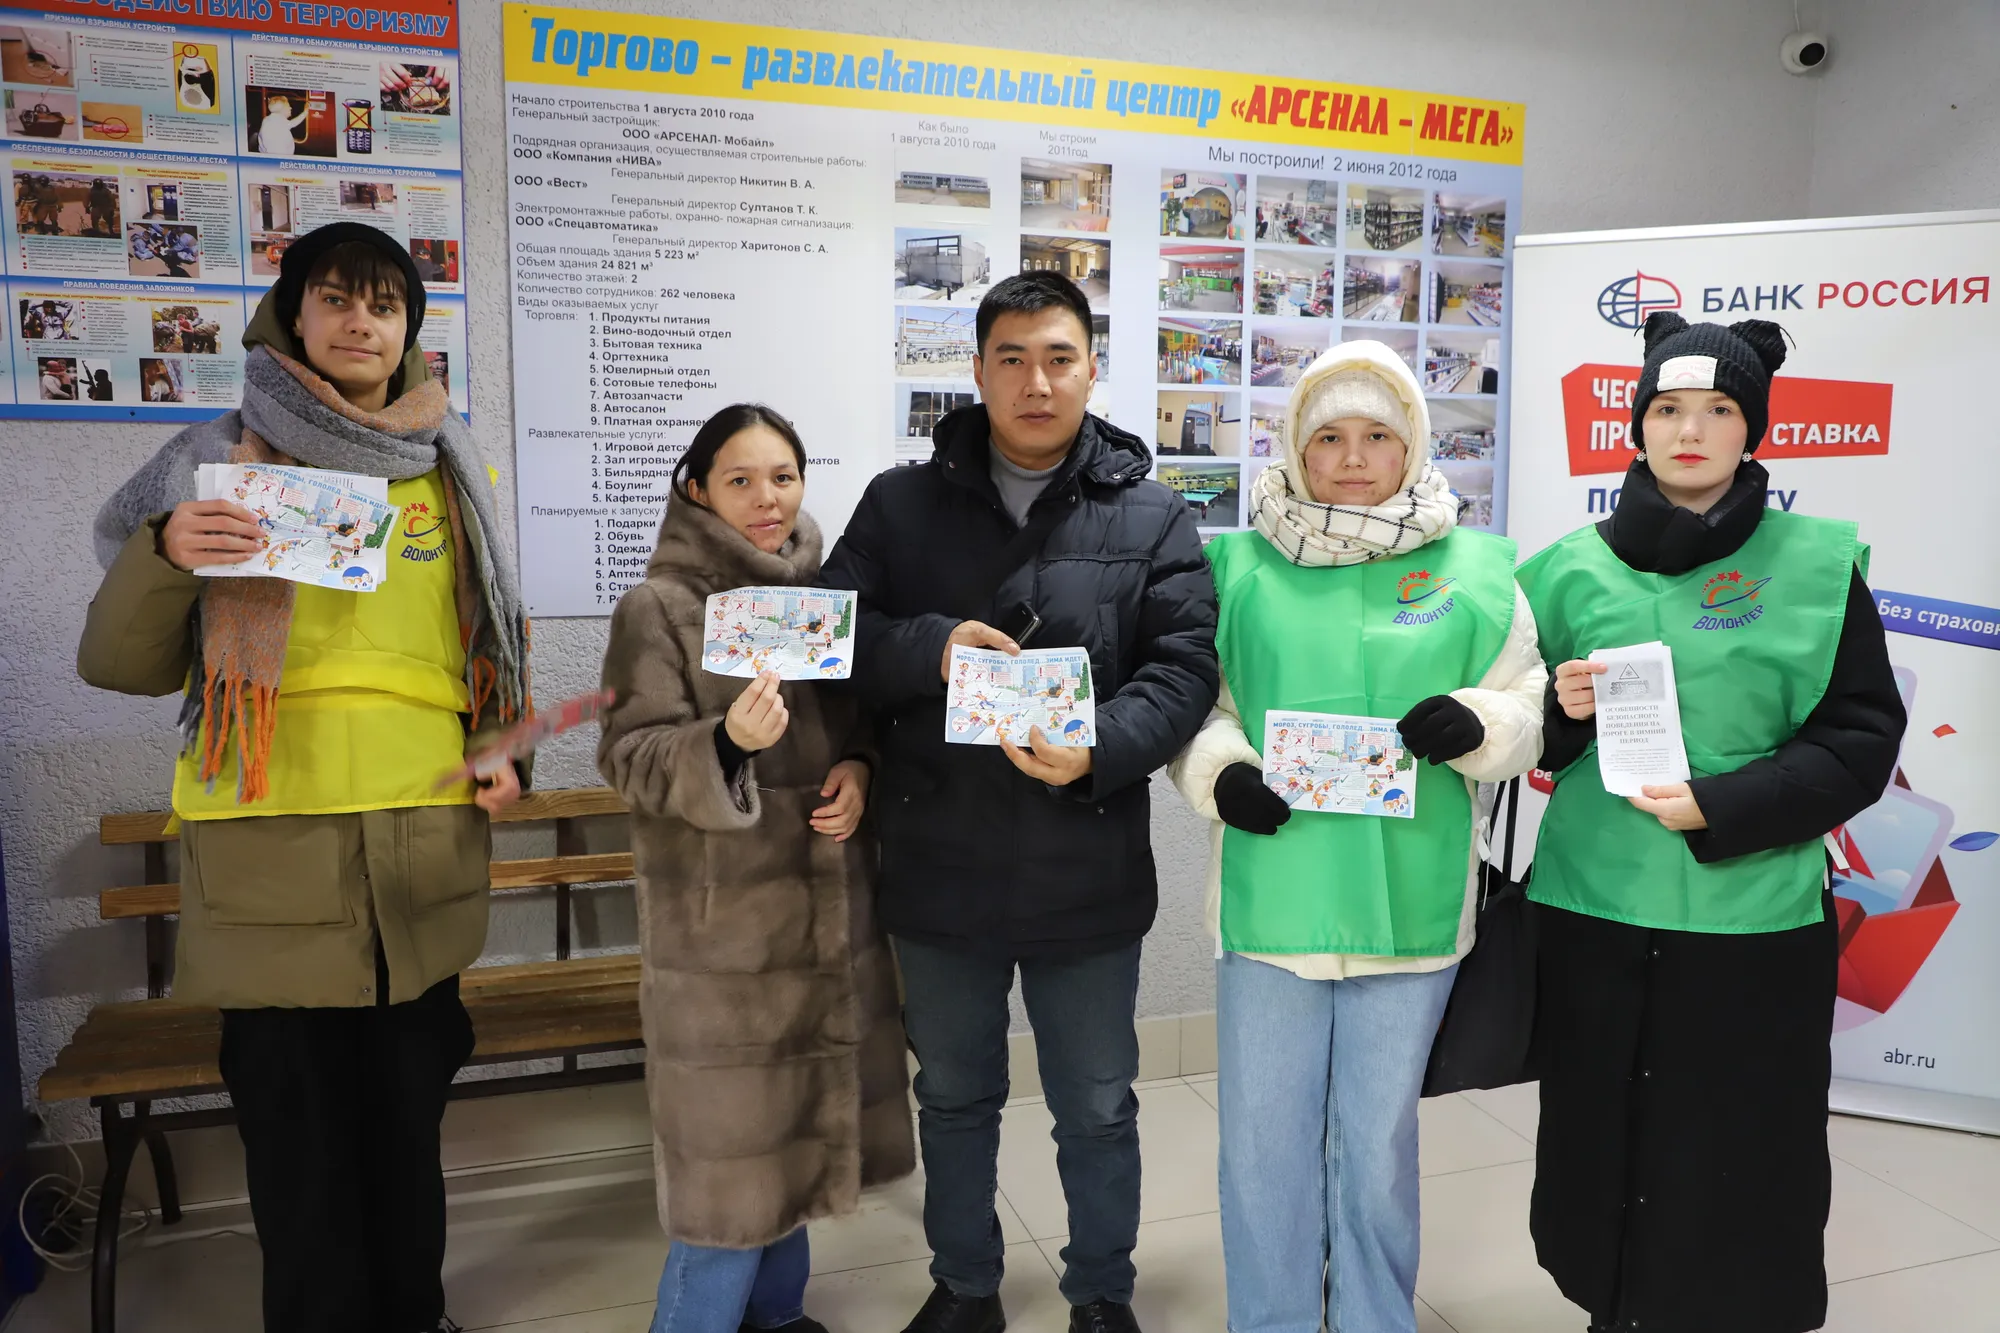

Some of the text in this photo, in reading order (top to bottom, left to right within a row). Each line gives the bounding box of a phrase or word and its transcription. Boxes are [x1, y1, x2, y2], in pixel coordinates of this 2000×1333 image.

[44, 14, 176, 34] ПРИЗНАКИ ВЗРЫВНЫХ УСТРОЙСТВ
[280, 2, 450, 37] ТЕРРОРИЗМУ
[252, 34, 444, 57] ДЕЙСТВИЯ ПРИ ОБНАРУЖЕНИИ ВЗРЫВНОГО УСТРОЙСТВА
[531, 17, 700, 76] Торгово
[742, 45, 1096, 109] развлекательный
[1105, 80, 1221, 128] центр
[1231, 84, 1388, 136] «АРСЕНАЛ
[1420, 102, 1514, 146] МЕГА»
[512, 93, 754, 121] Начало строительства 1 августа 2010 года
[512, 107, 660, 128] Генеральный застройщик:
[918, 120, 969, 134] Как было
[622, 128, 774, 148] ООО «АРСЕНАЛ- Мобайл»
[891, 132, 996, 151] 1 августа 2010 года
[1040, 130, 1096, 146] Мы строим
[12, 143, 68, 154] ОБЕСПЕЧЕНИЕ
[69, 148, 128, 159] БЕЗОПАСНОСТИ
[136, 152, 198, 164] ОБЩЕСТВЕННЫХ
[200, 156, 228, 164] МЕСТАХ
[513, 134, 866, 167] Подрядная организация, осуществляемая строительные работы:
[514, 148, 662, 166] ООО «Компания «НИВА»
[1048, 144, 1088, 158] 2011год
[280, 161, 318, 171] ДЕЙСТВИЯ
[328, 164, 392, 176] ПРЕДУПРЕЖДЕНИЮ
[394, 168, 436, 178] ТЕРРОРИЗМА
[1209, 146, 1456, 183] Мы построили! 2 июня 2012 года
[514, 175, 588, 188] ООО «Вест»
[611, 167, 815, 189] Генеральный директор Никитин В. А.
[612, 194, 818, 214] Генеральный директор Султанов Т. К.
[515, 202, 626, 218] Электромонтажные
[629, 208, 671, 220] работы,
[726, 216, 778, 226] пожарная
[781, 218, 854, 230] сигнализация:
[516, 216, 658, 232] ООО «Спецавтоматика»
[516, 242, 556, 254] Общая
[560, 247, 610, 258] площадь
[613, 249, 651, 258] здания
[655, 249, 661, 258] 5
[664, 250, 684, 259] 223
[612, 234, 828, 253] Генеральный директор Харитонов С. А.
[516, 256, 555, 267] Объем
[559, 260, 598, 269] здания
[601, 260, 614, 269] 24
[618, 260, 636, 270] 821
[517, 269, 637, 284] Количество этажей: 2
[63, 281, 195, 293] ПРАВИЛА ПОВЕДЕНИЯ ЗАЛОЖНИКОВ
[518, 282, 735, 300] Количество сотрудников: 262 человека
[1702, 276, 1990, 313] БАНК РОССИЯ
[518, 296, 659, 312] Виды оказываемых услуг
[524, 309, 710, 325] Торговля: 1. Продукты питания
[590, 325, 731, 339] 2. Вино-водочный отдел
[590, 338, 702, 350] 3. Бытовая техника
[590, 364, 710, 377] 5. Ювелирный отдел
[528, 428, 666, 441] Развлекательные услуги:
[1772, 422, 1880, 446] СТАВКА
[270, 468, 306, 484] СУГРОБЫ,
[369, 500, 390, 512] ИДЕТ!
[531, 506, 608, 518] Планируемые
[620, 508, 660, 518] запуску
[595, 519, 656, 530] 1. Подарки
[1392, 597, 1455, 626] ВОЛОНТЕР
[1692, 604, 1764, 631] ВОЛОНТЕР
[1878, 598, 1912, 620] Без
[1605, 705, 1658, 713] ОСОБЕННОСТИ
[1601, 730, 1629, 738] ДОРОГЕ
[1884, 1048, 1935, 1069] abr.ru
